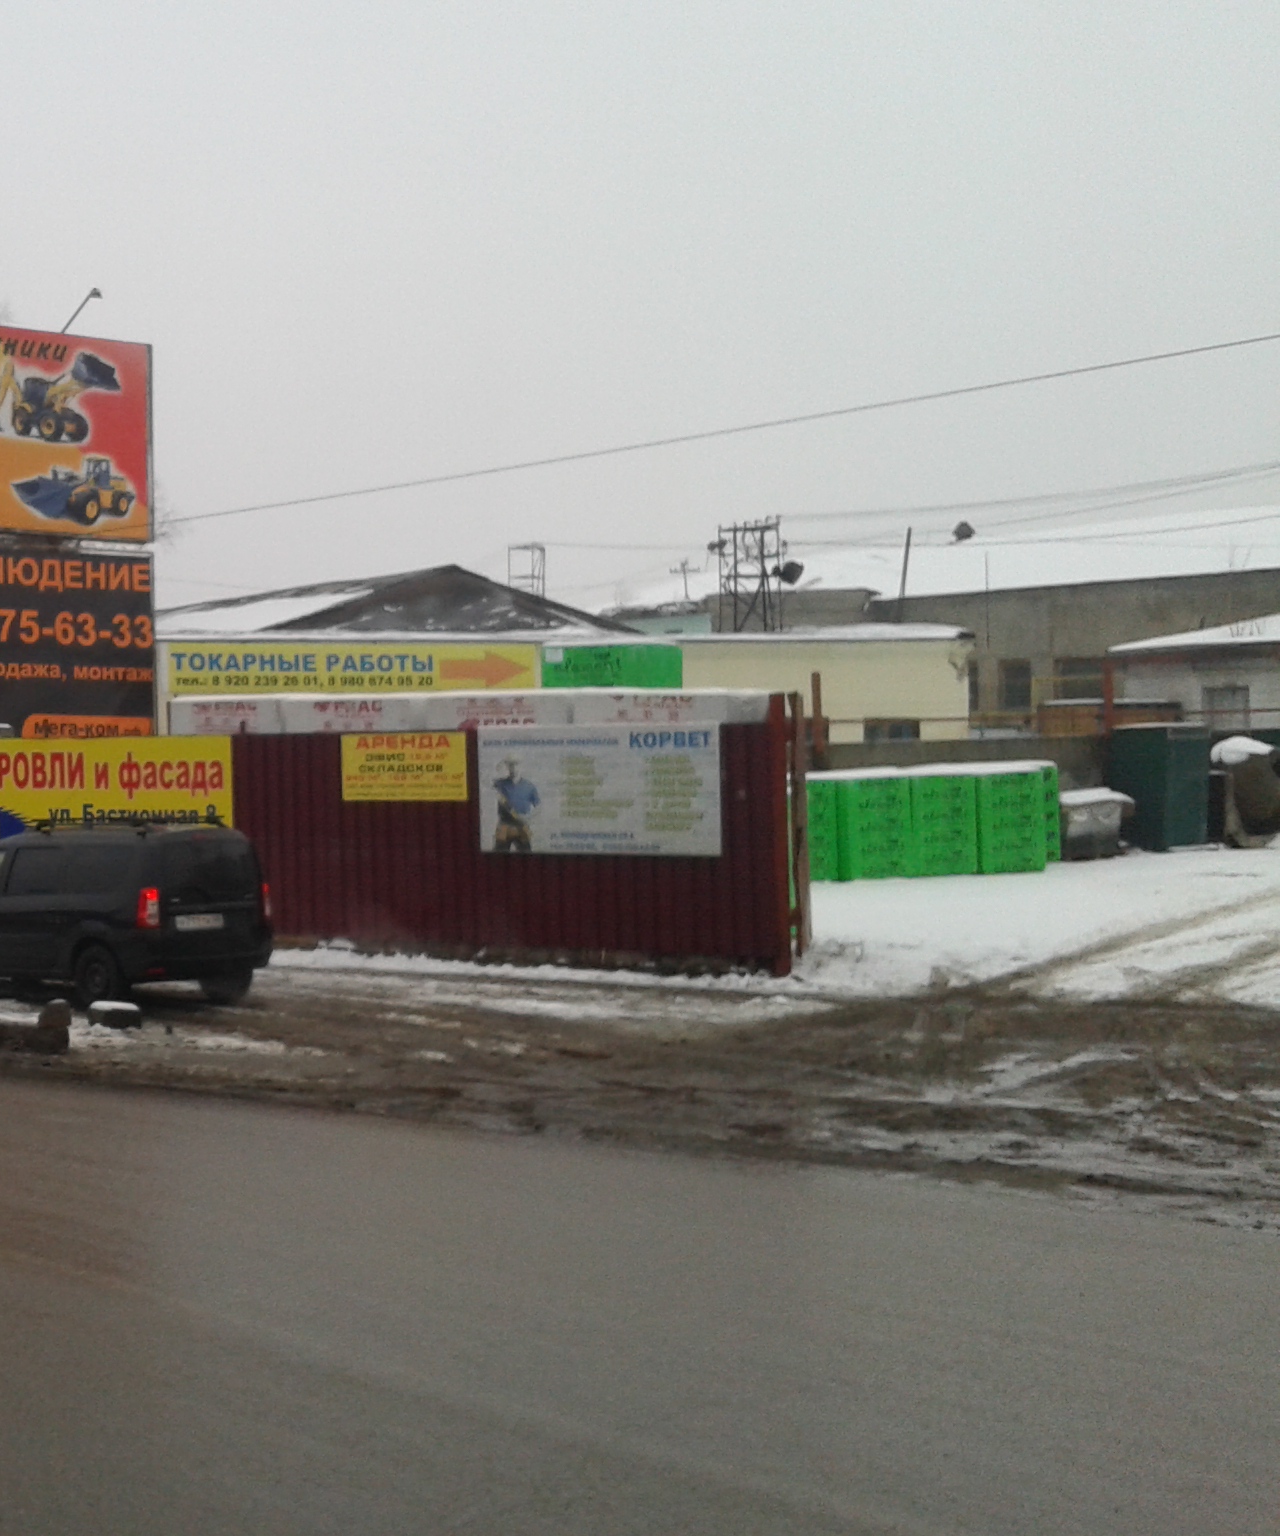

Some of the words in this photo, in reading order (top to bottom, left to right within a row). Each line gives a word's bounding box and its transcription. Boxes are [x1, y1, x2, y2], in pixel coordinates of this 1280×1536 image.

[171, 652, 317, 673] ТОКАРНЫЕ
[326, 653, 434, 673] РАБОТЫ
[212, 676, 220, 686] 8
[224, 676, 249, 686] 920
[418, 676, 433, 686] 20
[356, 735, 450, 749] АРЕНДА
[629, 731, 711, 748] КОРВЕТ
[95, 761, 109, 790] и
[119, 751, 224, 800] фасада
